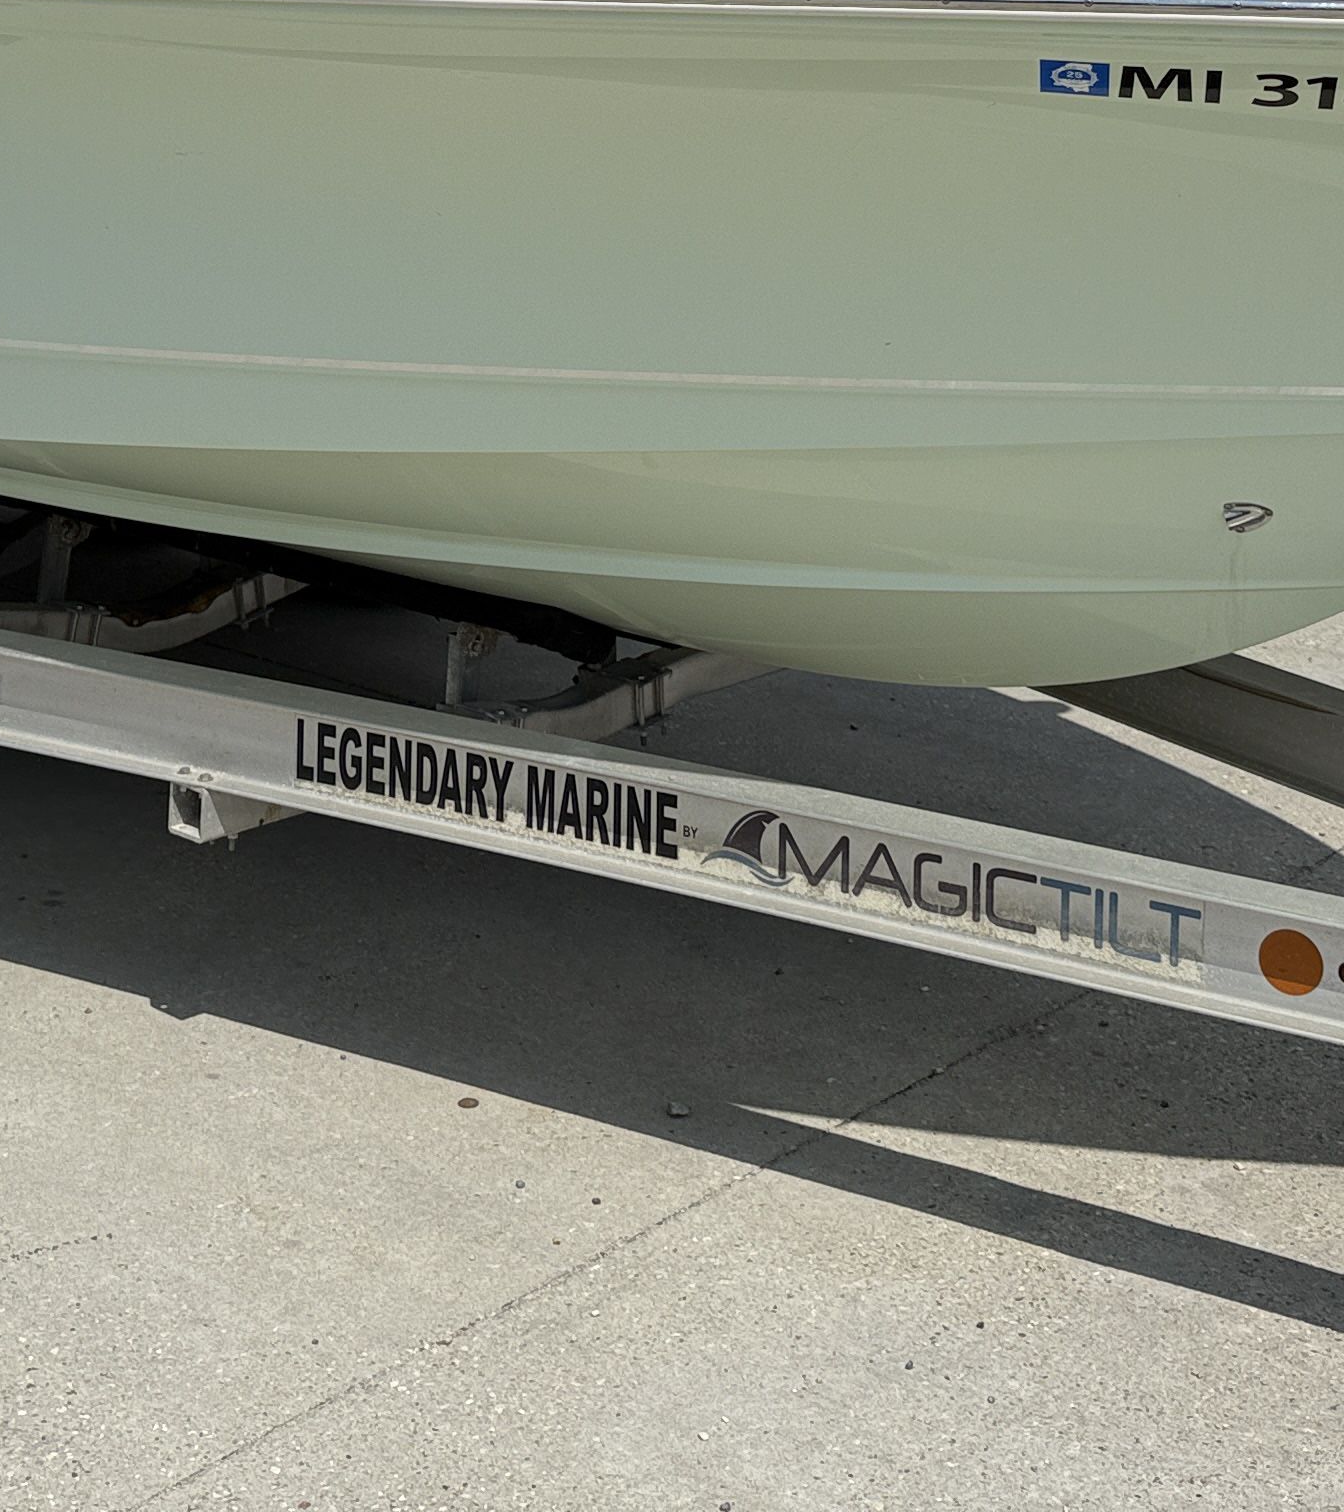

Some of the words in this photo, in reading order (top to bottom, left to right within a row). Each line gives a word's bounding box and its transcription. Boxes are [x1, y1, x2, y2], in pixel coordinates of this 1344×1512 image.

[1118, 66, 1223, 104] MI
[296, 718, 514, 823] LEGENDARY
[526, 765, 679, 860] MARINE
[682, 825, 698, 840] BY
